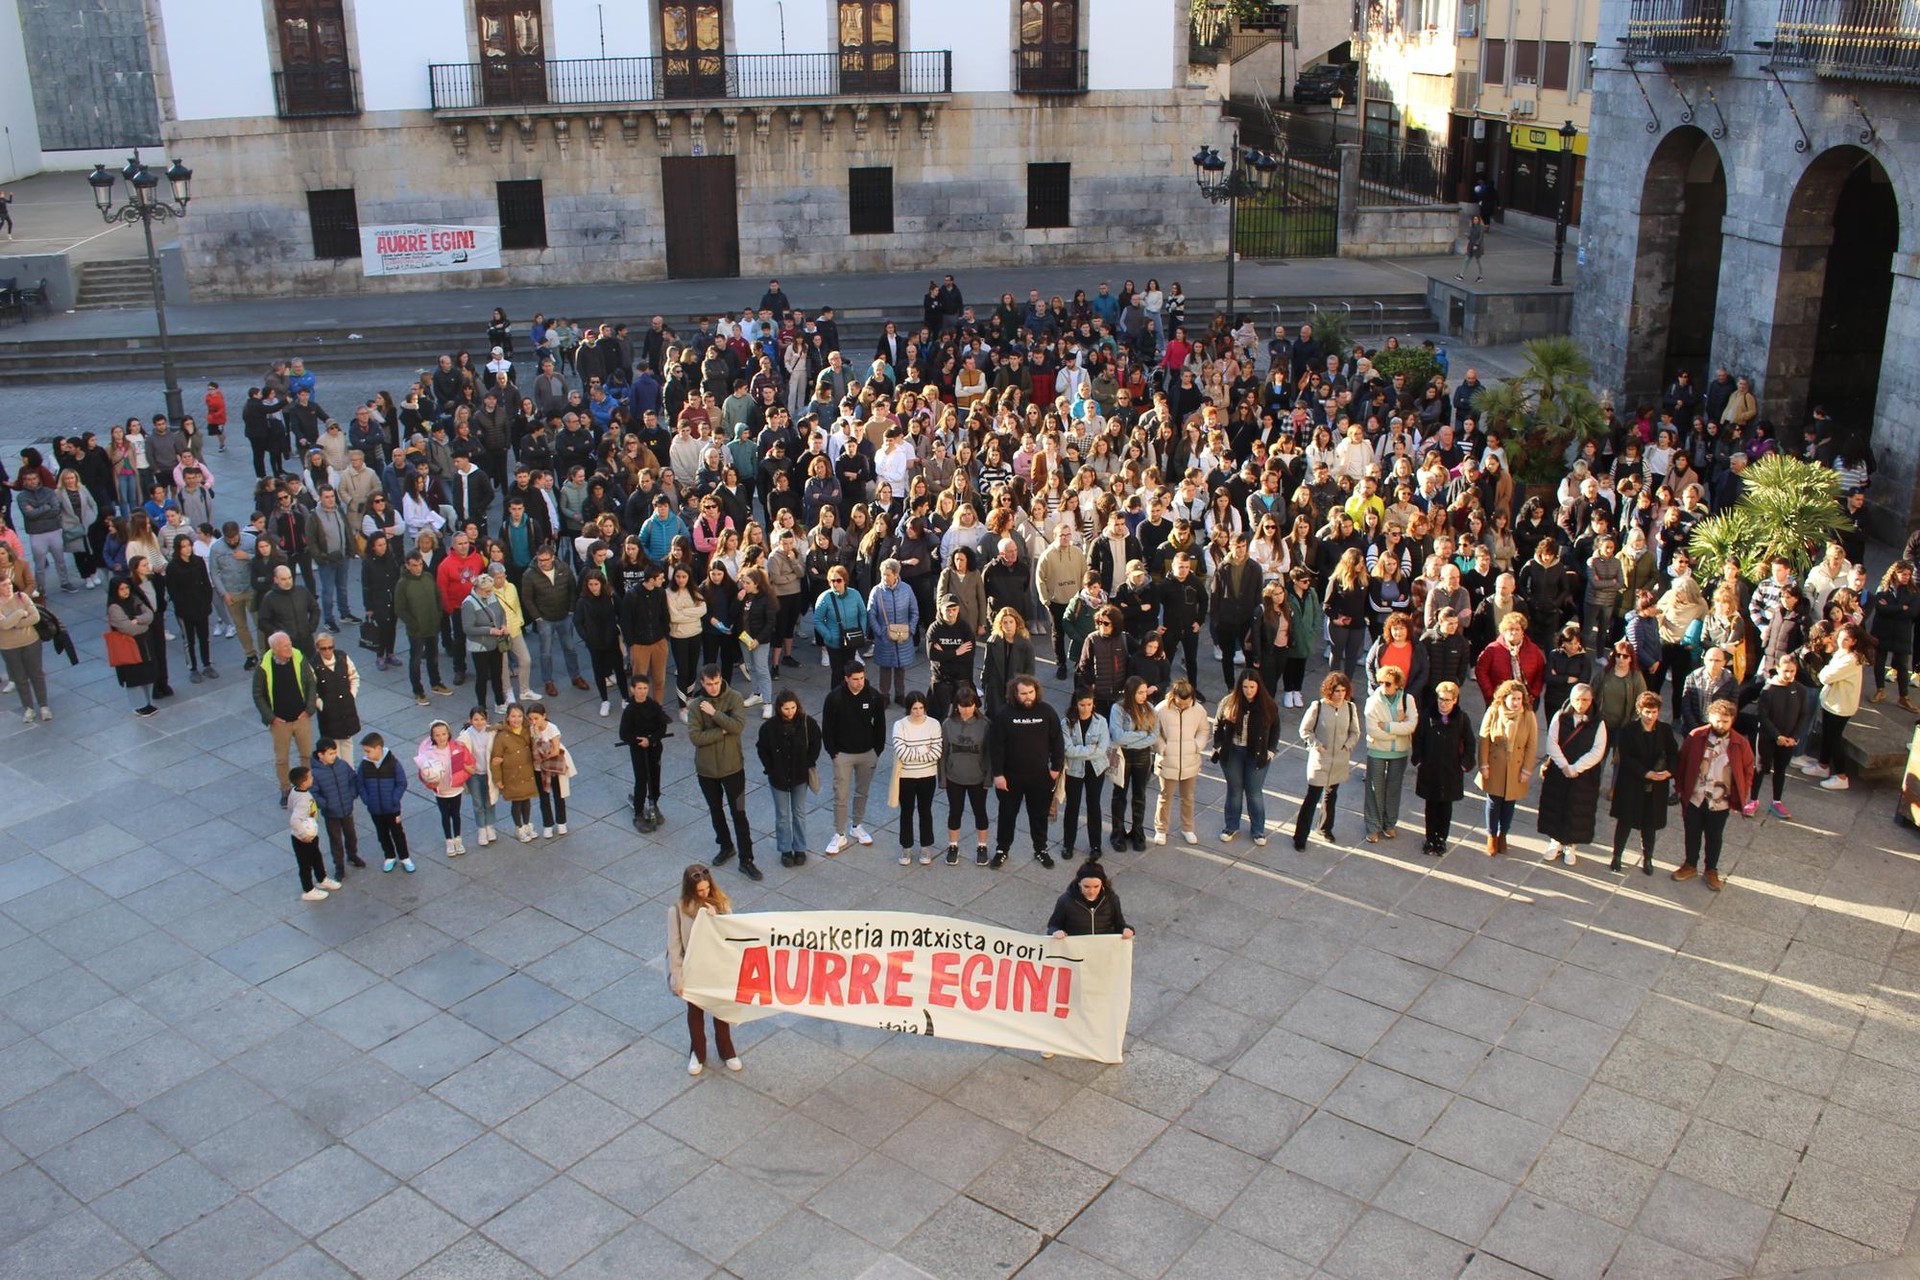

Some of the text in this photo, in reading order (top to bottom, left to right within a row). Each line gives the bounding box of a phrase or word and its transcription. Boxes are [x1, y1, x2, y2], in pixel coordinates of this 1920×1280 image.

[377, 230, 475, 253] AURRE EGIN!
[770, 922, 1043, 961] indarkeria matxista orori
[735, 946, 1073, 1019] AURRE EGIN!
